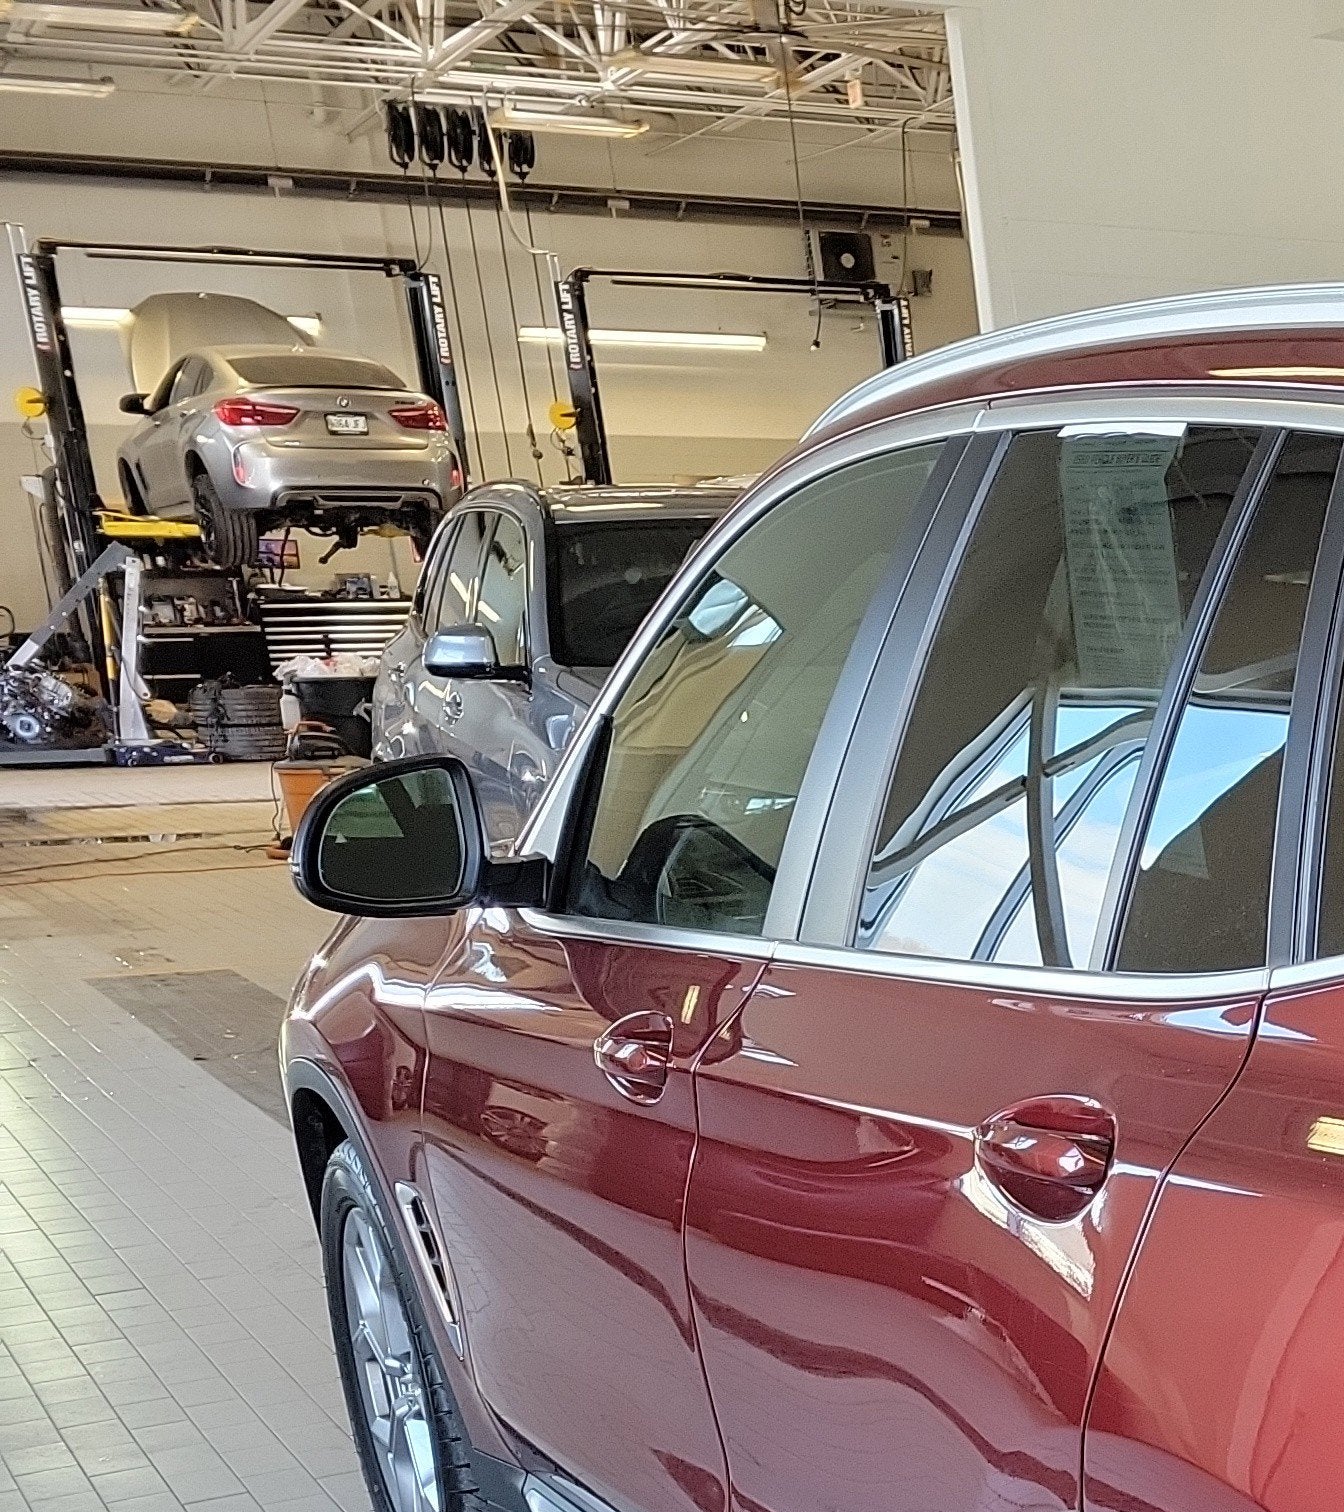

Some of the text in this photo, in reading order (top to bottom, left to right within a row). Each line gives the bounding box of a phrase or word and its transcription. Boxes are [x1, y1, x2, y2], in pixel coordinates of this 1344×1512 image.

[20, 256, 50, 343] ROTARY LIFT
[428, 275, 451, 358] ROTARY LIFT
[558, 282, 582, 363] ROTARY LIFT
[903, 326, 913, 357] TARY
